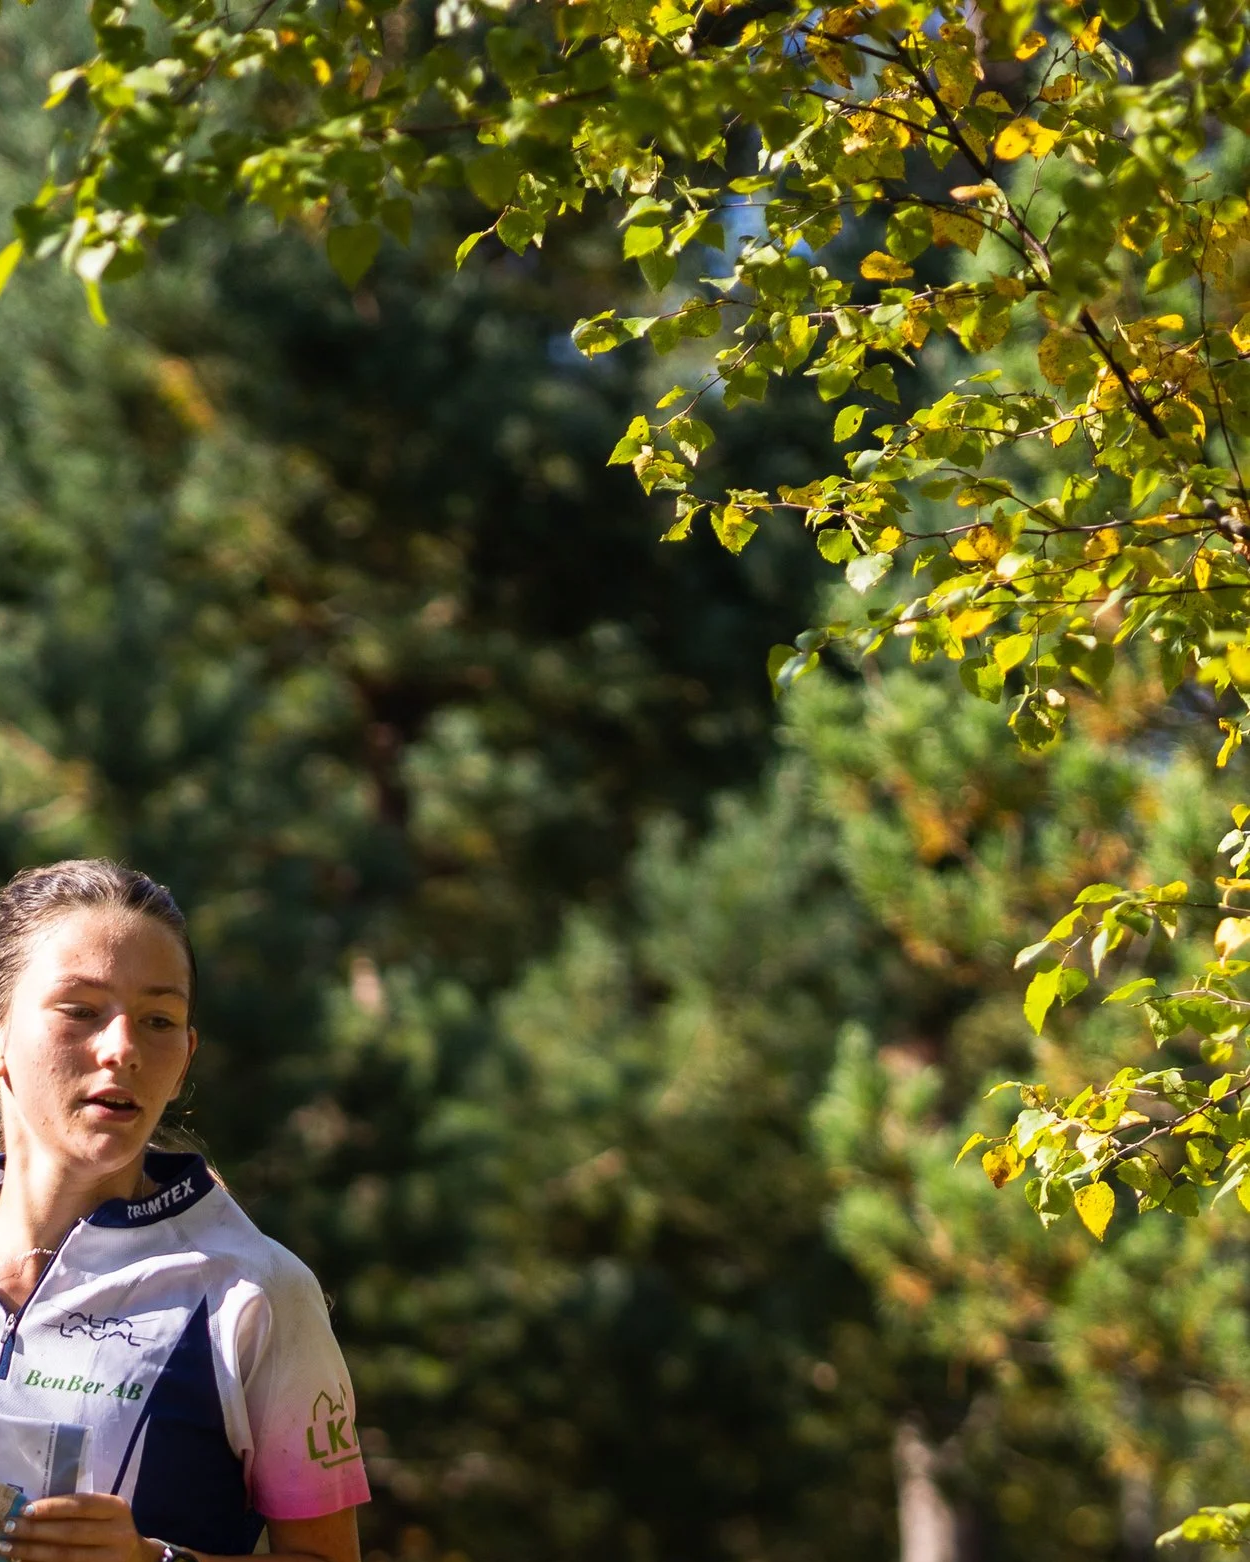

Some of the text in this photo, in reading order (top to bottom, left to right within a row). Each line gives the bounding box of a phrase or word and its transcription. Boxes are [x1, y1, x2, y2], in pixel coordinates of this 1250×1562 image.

[127, 1176, 195, 1219] TRIMTEX
[23, 1369, 144, 1401] BenBer AB
